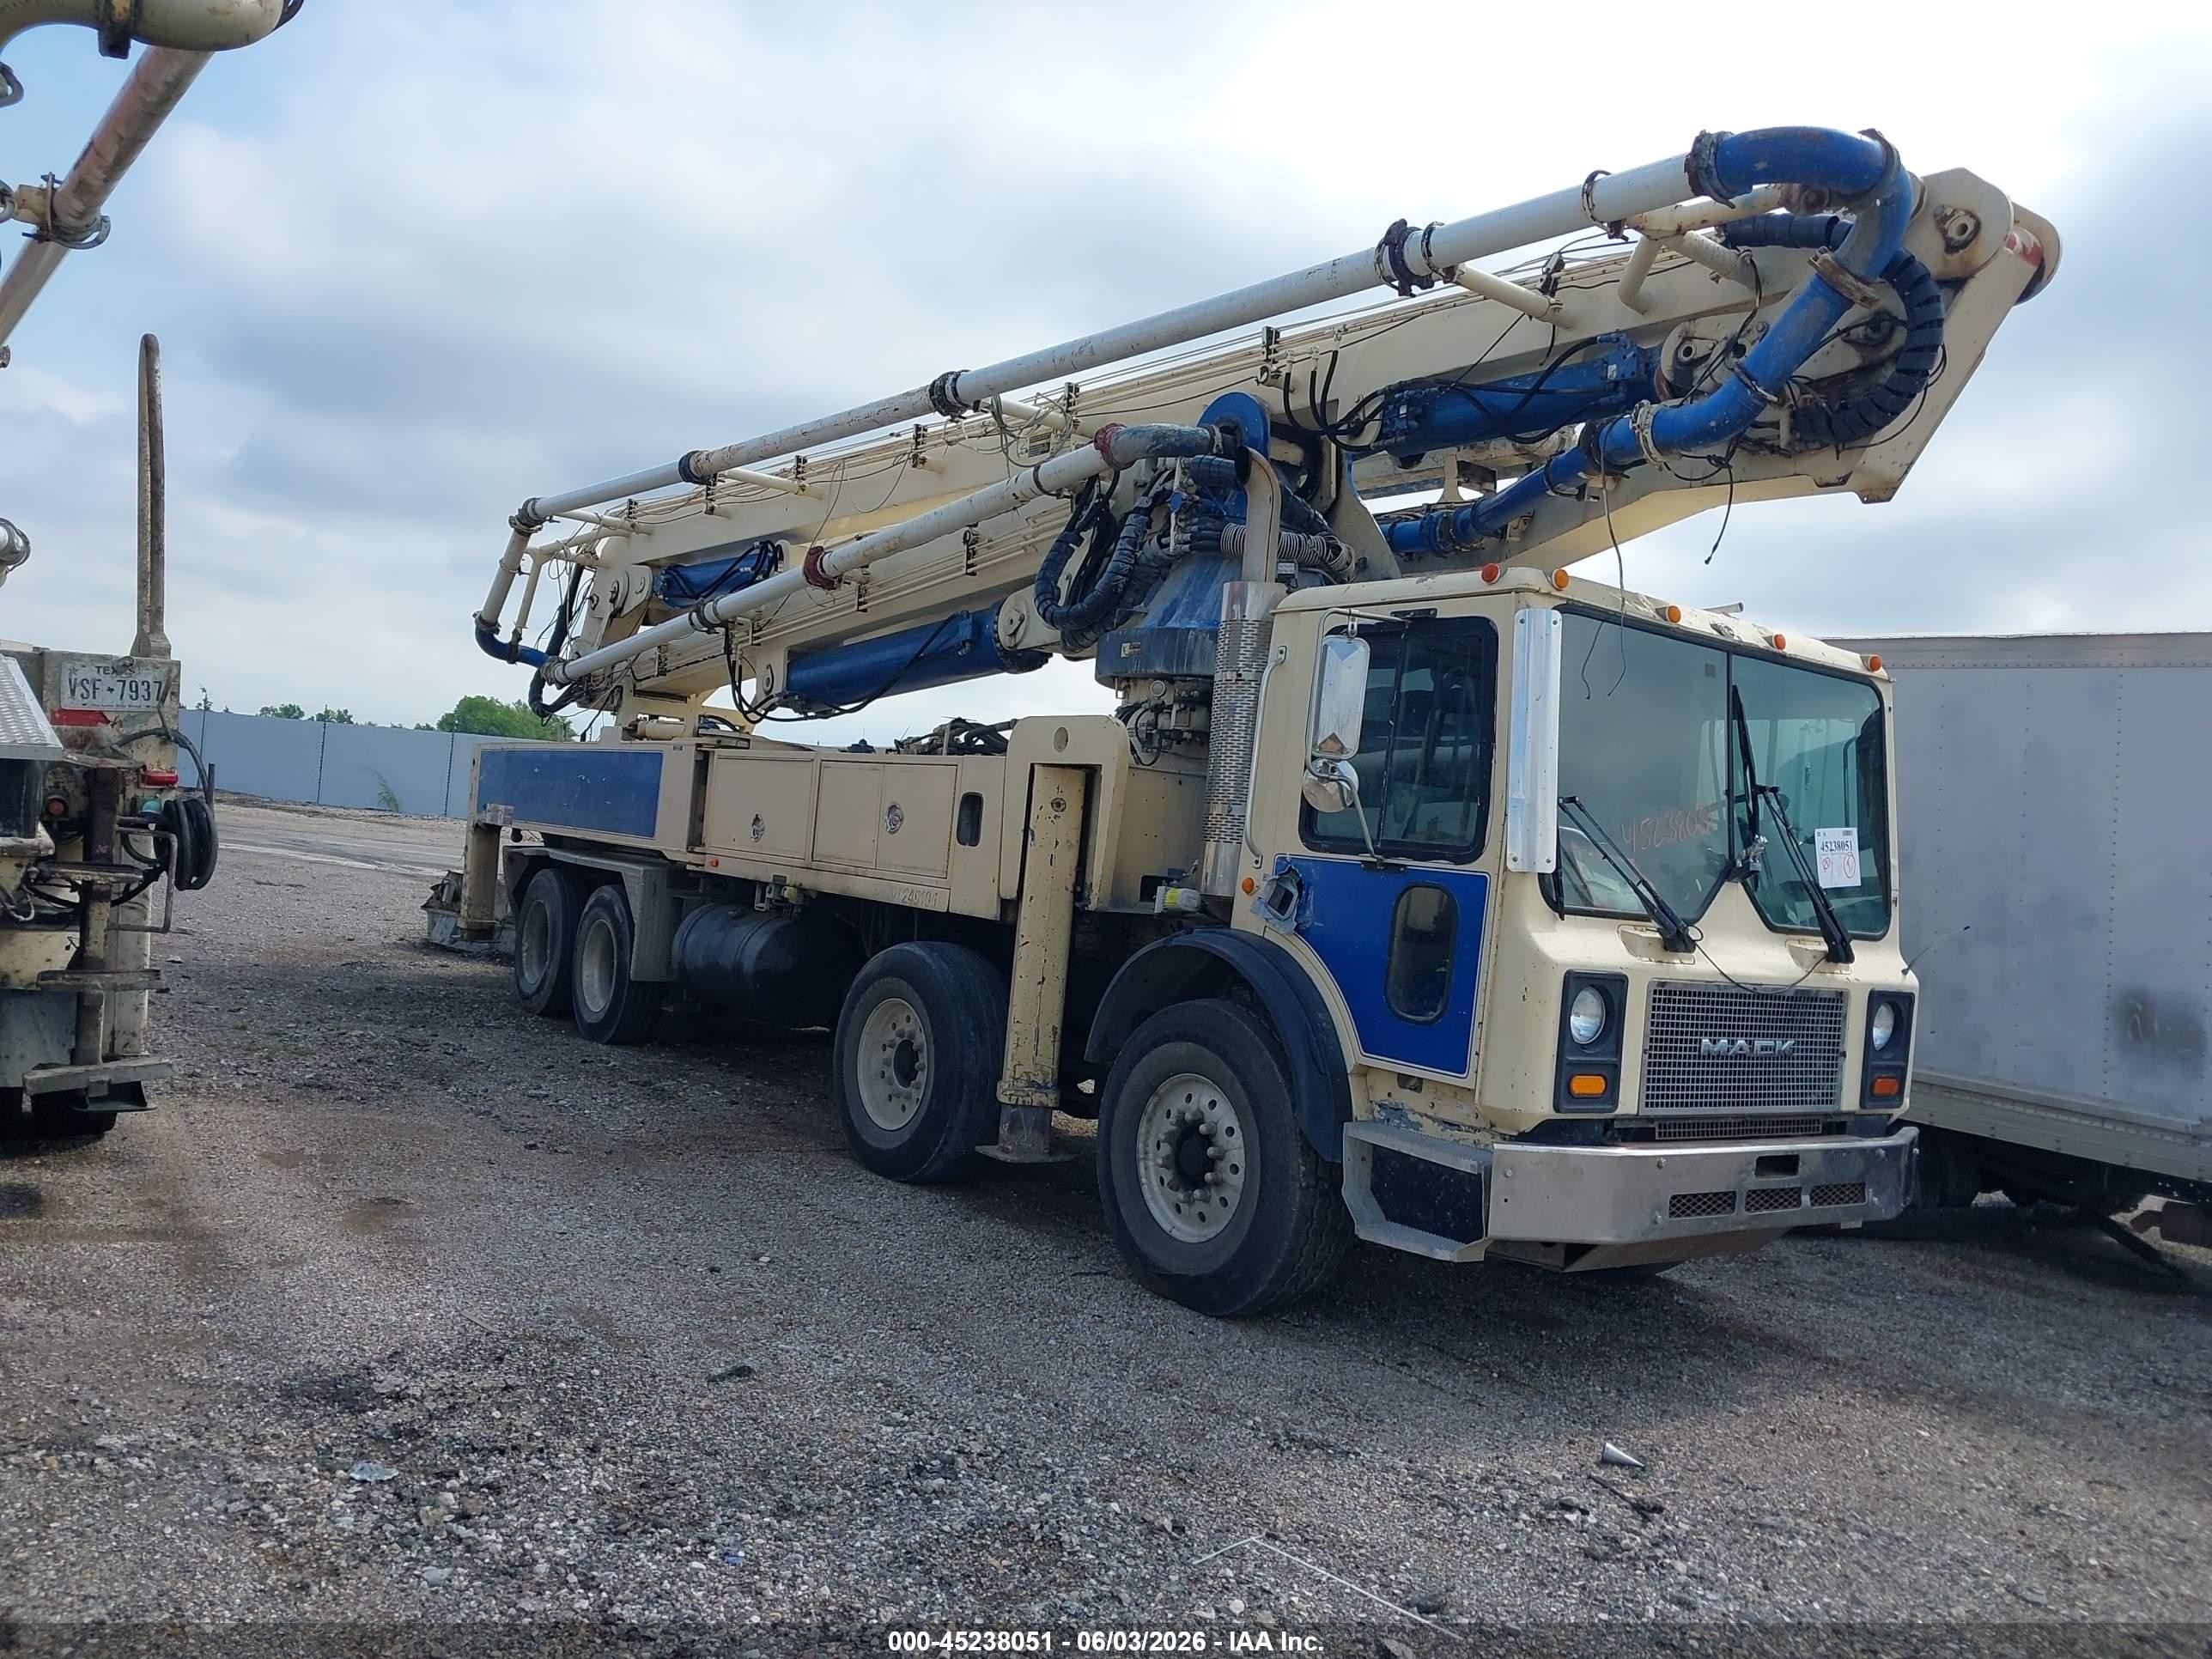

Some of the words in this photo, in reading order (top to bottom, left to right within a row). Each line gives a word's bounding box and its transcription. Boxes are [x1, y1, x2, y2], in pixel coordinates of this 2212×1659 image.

[95, 665, 136, 676] TEX
[69, 678, 101, 700] VSF
[117, 679, 162, 702] 7937
[1820, 840, 1853, 853] 45238051
[1700, 1038, 1796, 1057] MACK
